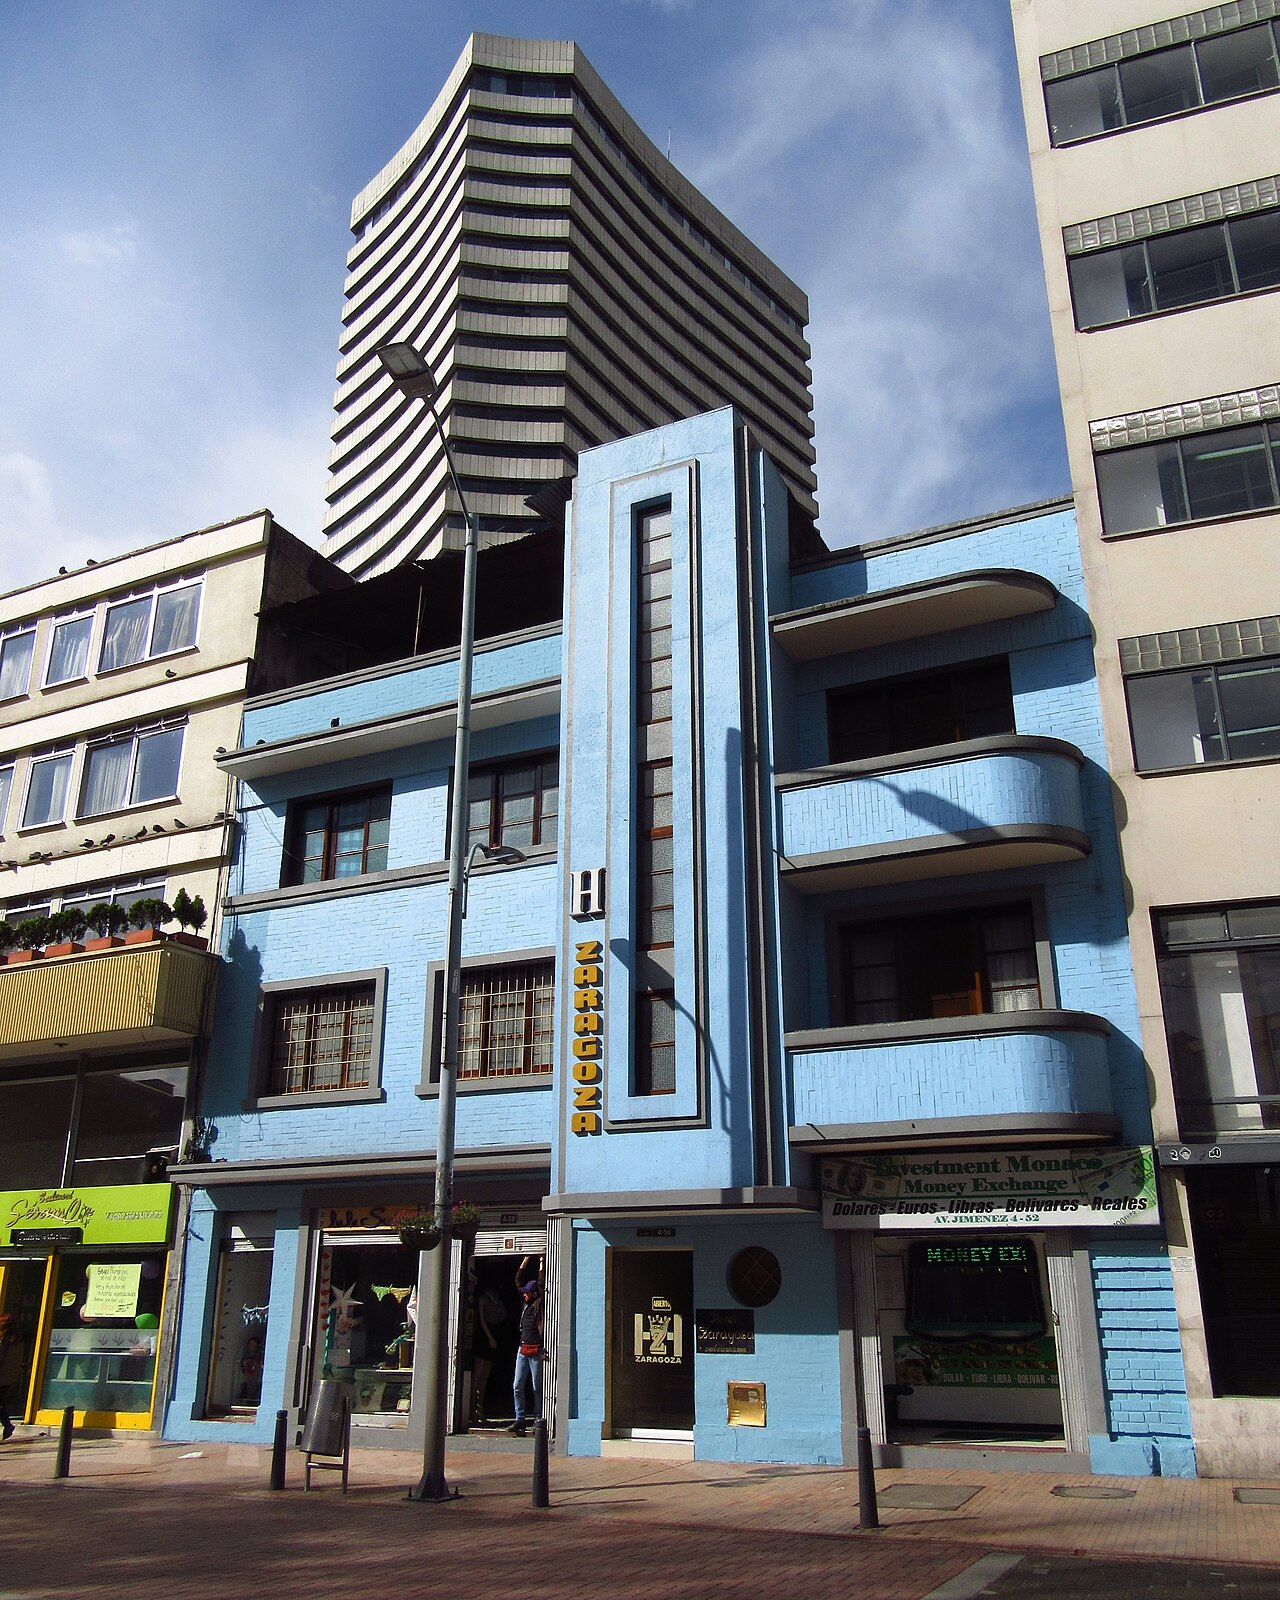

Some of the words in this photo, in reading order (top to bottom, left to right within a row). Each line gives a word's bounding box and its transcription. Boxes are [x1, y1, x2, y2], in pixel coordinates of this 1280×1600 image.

[570, 868, 606, 919] H
[571, 941, 603, 1135] ZARAGOZA
[875, 1157, 1001, 1176] Investment
[1005, 1154, 1103, 1173] Monaco
[903, 1178, 967, 1196] Money
[971, 1176, 1068, 1193] Exchange
[832, 1202, 886, 1216] Dolares
[896, 1201, 938, 1215] Euros
[948, 1200, 995, 1214] Libras
[1005, 1198, 1080, 1213] Bolivares
[1091, 1196, 1148, 1211] Reales
[934, 1216, 951, 1224] AV.
[952, 1215, 1009, 1224] JIMENEZ
[1010, 1215, 1018, 1223] 4
[1025, 1214, 1040, 1223] 52
[928, 1247, 993, 1262] MONEY
[698, 1326, 755, 1345] Zaragoza
[635, 1355, 682, 1364] ZARAGOZA
[971, 1374, 988, 1383] EURO
[1018, 1374, 1046, 1384] BOLIVAR
